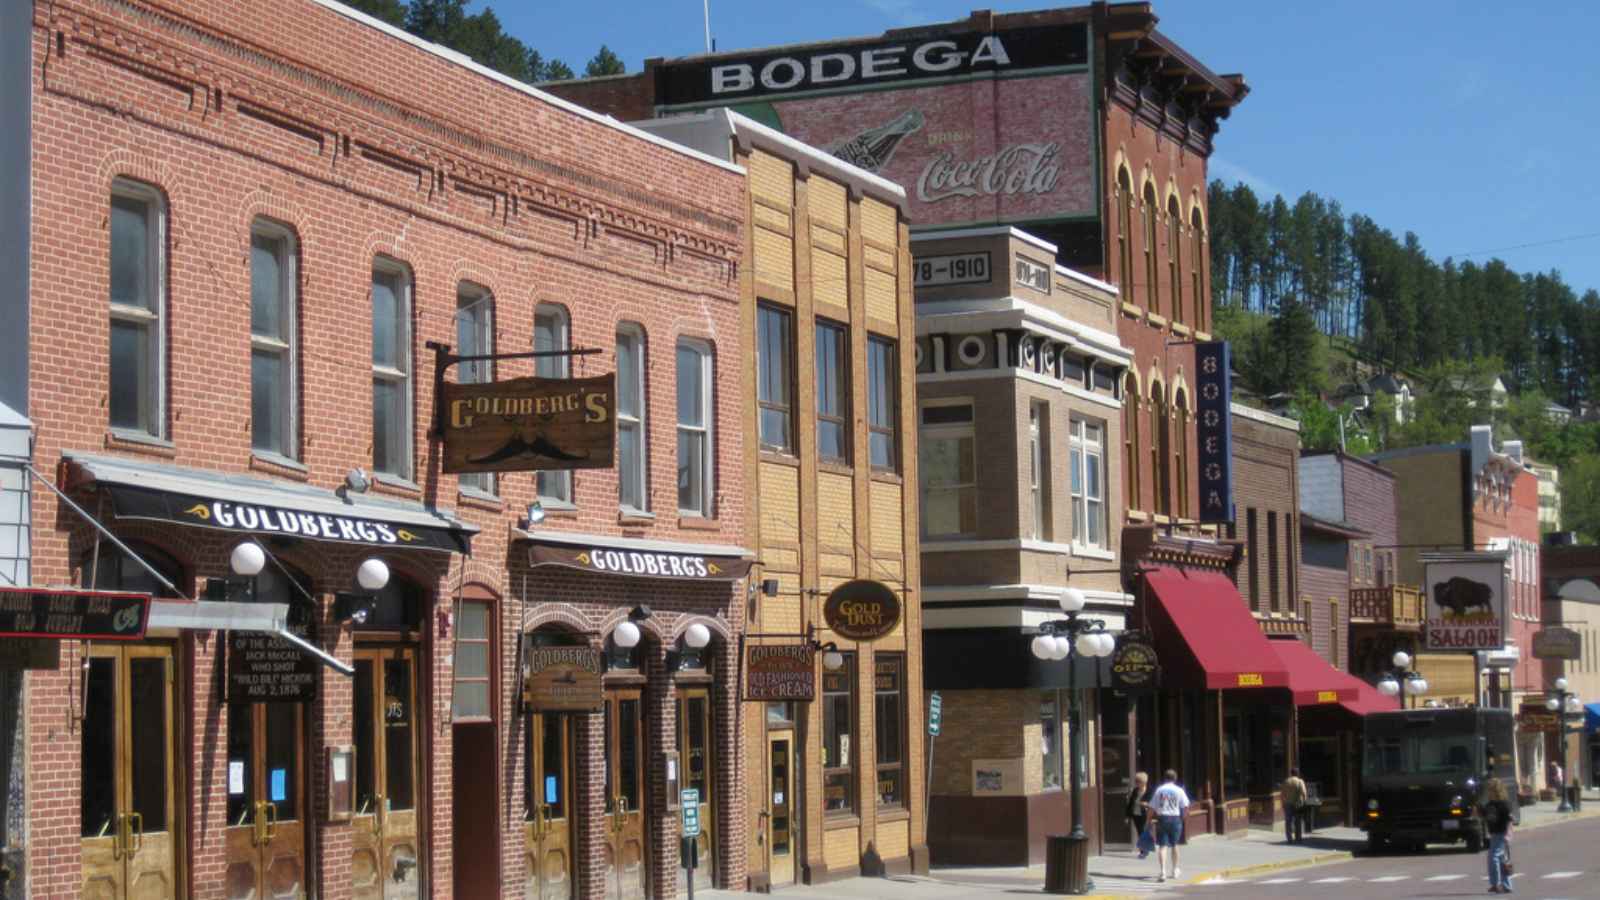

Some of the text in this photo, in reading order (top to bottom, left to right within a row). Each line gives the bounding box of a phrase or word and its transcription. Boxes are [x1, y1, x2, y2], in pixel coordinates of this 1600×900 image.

[711, 36, 1011, 94] BODEGA
[451, 387, 608, 429] GOLDBERG'S
[1202, 356, 1222, 508] BODEGA
[840, 600, 880, 616] GOLD
[848, 613, 882, 625] DUST
[235, 639, 246, 649] OF
[250, 639, 264, 649] THE
[1430, 628, 1499, 647] SALOON
[246, 651, 265, 661] JACK
[251, 662, 295, 672] WHO SHOT
[771, 681, 812, 697] CREAM
